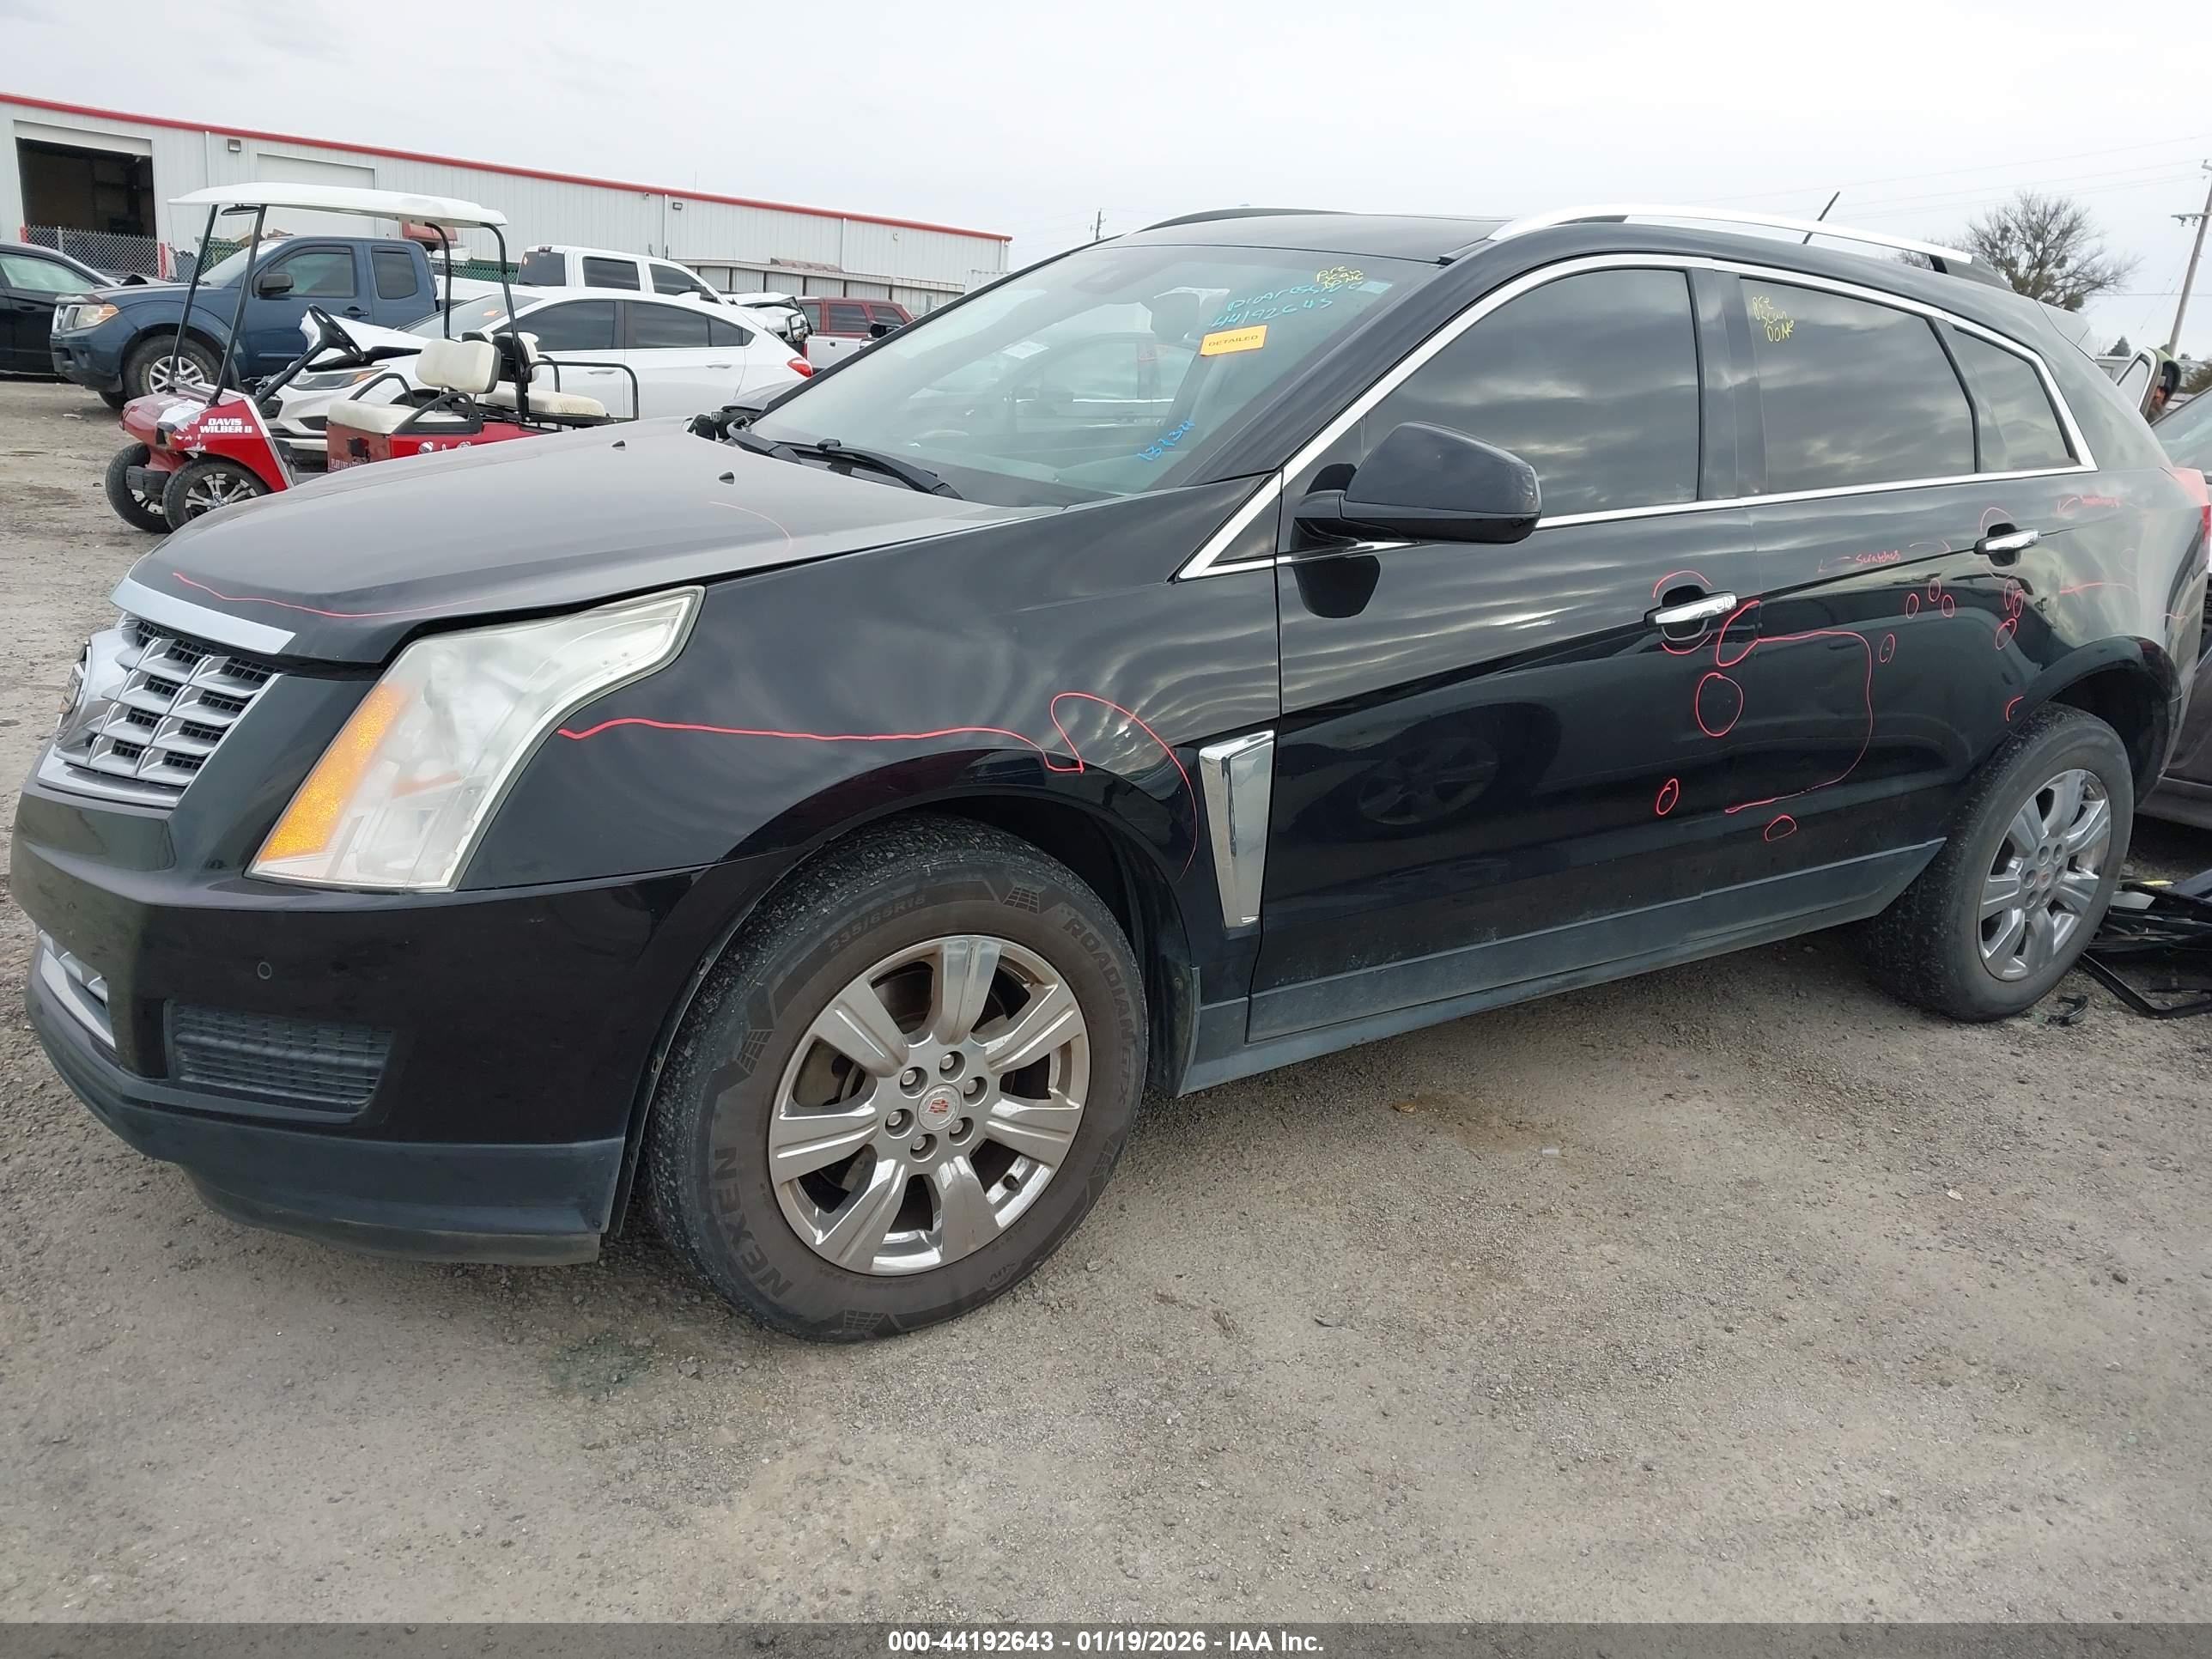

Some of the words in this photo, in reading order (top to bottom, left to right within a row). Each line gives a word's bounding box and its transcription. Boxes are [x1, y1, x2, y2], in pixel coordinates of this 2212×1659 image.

[1207, 334, 1259, 347] DETAILED
[199, 425, 243, 434] WILBER
[1062, 917, 1137, 1046] ROADIAN
[714, 1146, 793, 1299] NEXEN
